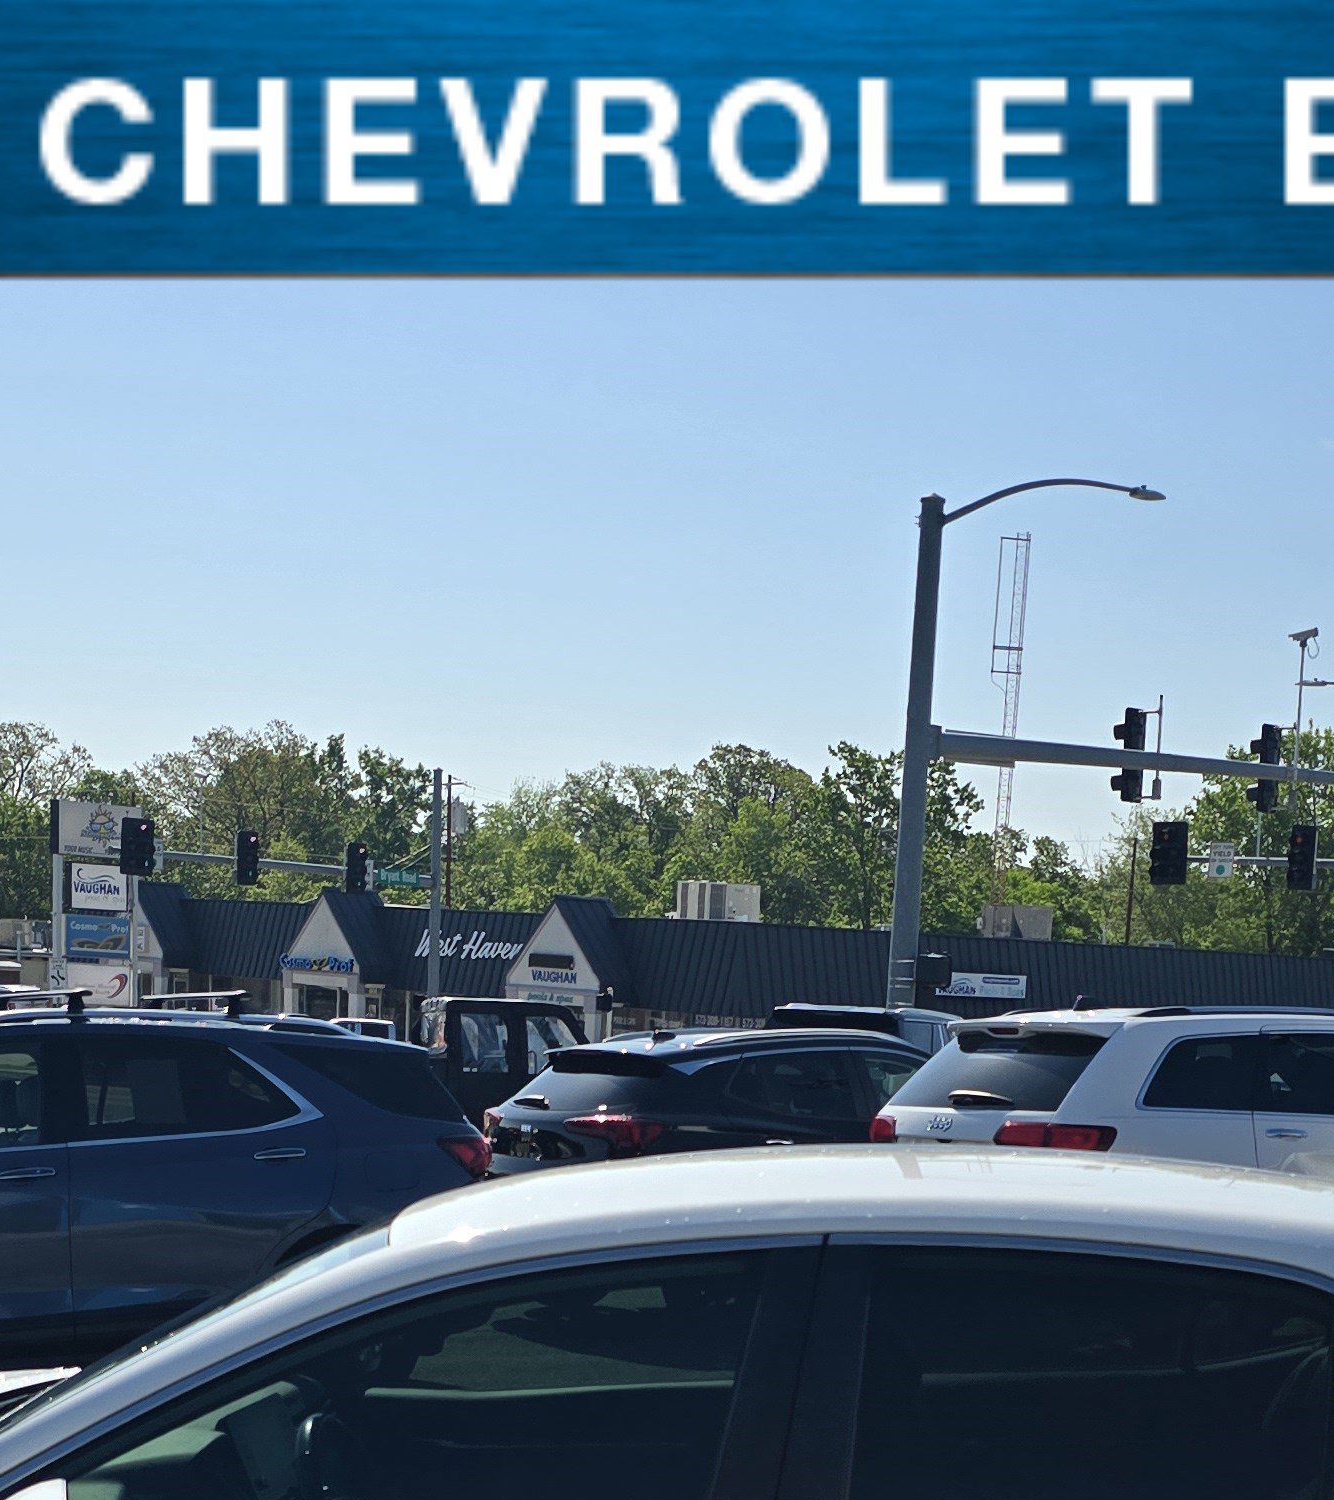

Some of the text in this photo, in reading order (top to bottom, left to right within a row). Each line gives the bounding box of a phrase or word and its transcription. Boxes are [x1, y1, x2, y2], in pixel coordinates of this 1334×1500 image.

[73, 881, 120, 895] VAUGHAN
[70, 921, 98, 932] Cosmo
[279, 952, 355, 972] Cosmo Prof
[531, 969, 577, 984] VAUGHAN
